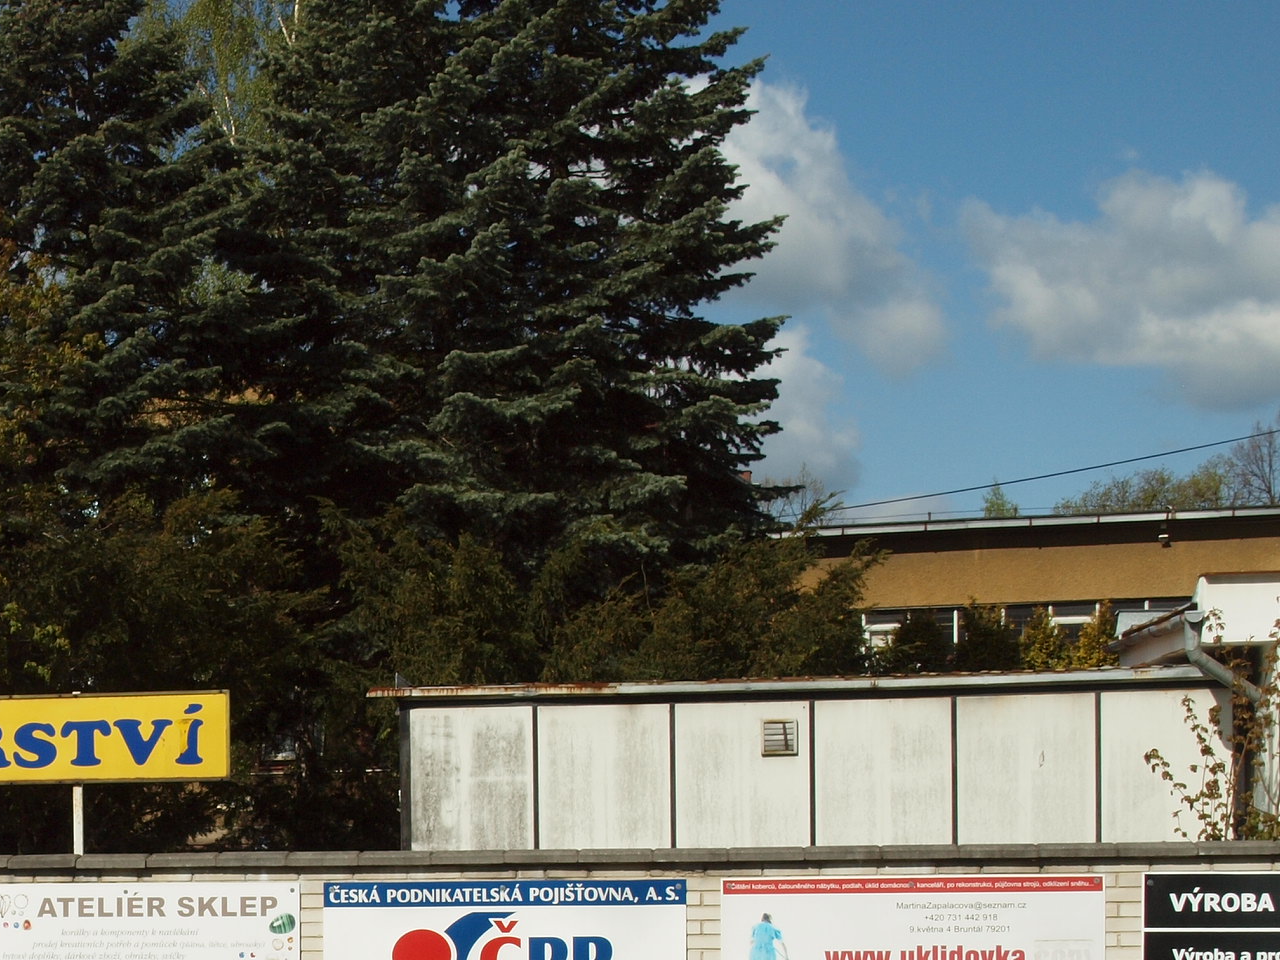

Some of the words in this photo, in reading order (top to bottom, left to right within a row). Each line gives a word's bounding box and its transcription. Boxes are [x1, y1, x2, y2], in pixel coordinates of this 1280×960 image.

[37, 892, 166, 917] ATELIÉR
[177, 896, 278, 917] SKLEP
[329, 885, 380, 903] ČESKÁ
[386, 884, 522, 902] PODNIKATELSKÁ
[529, 884, 639, 903] POJIŠŤOVNA,
[646, 887, 661, 900] A.
[665, 886, 679, 900] S.
[1170, 887, 1275, 912] VÝROBA
[954, 925, 983, 933] Bruntál
